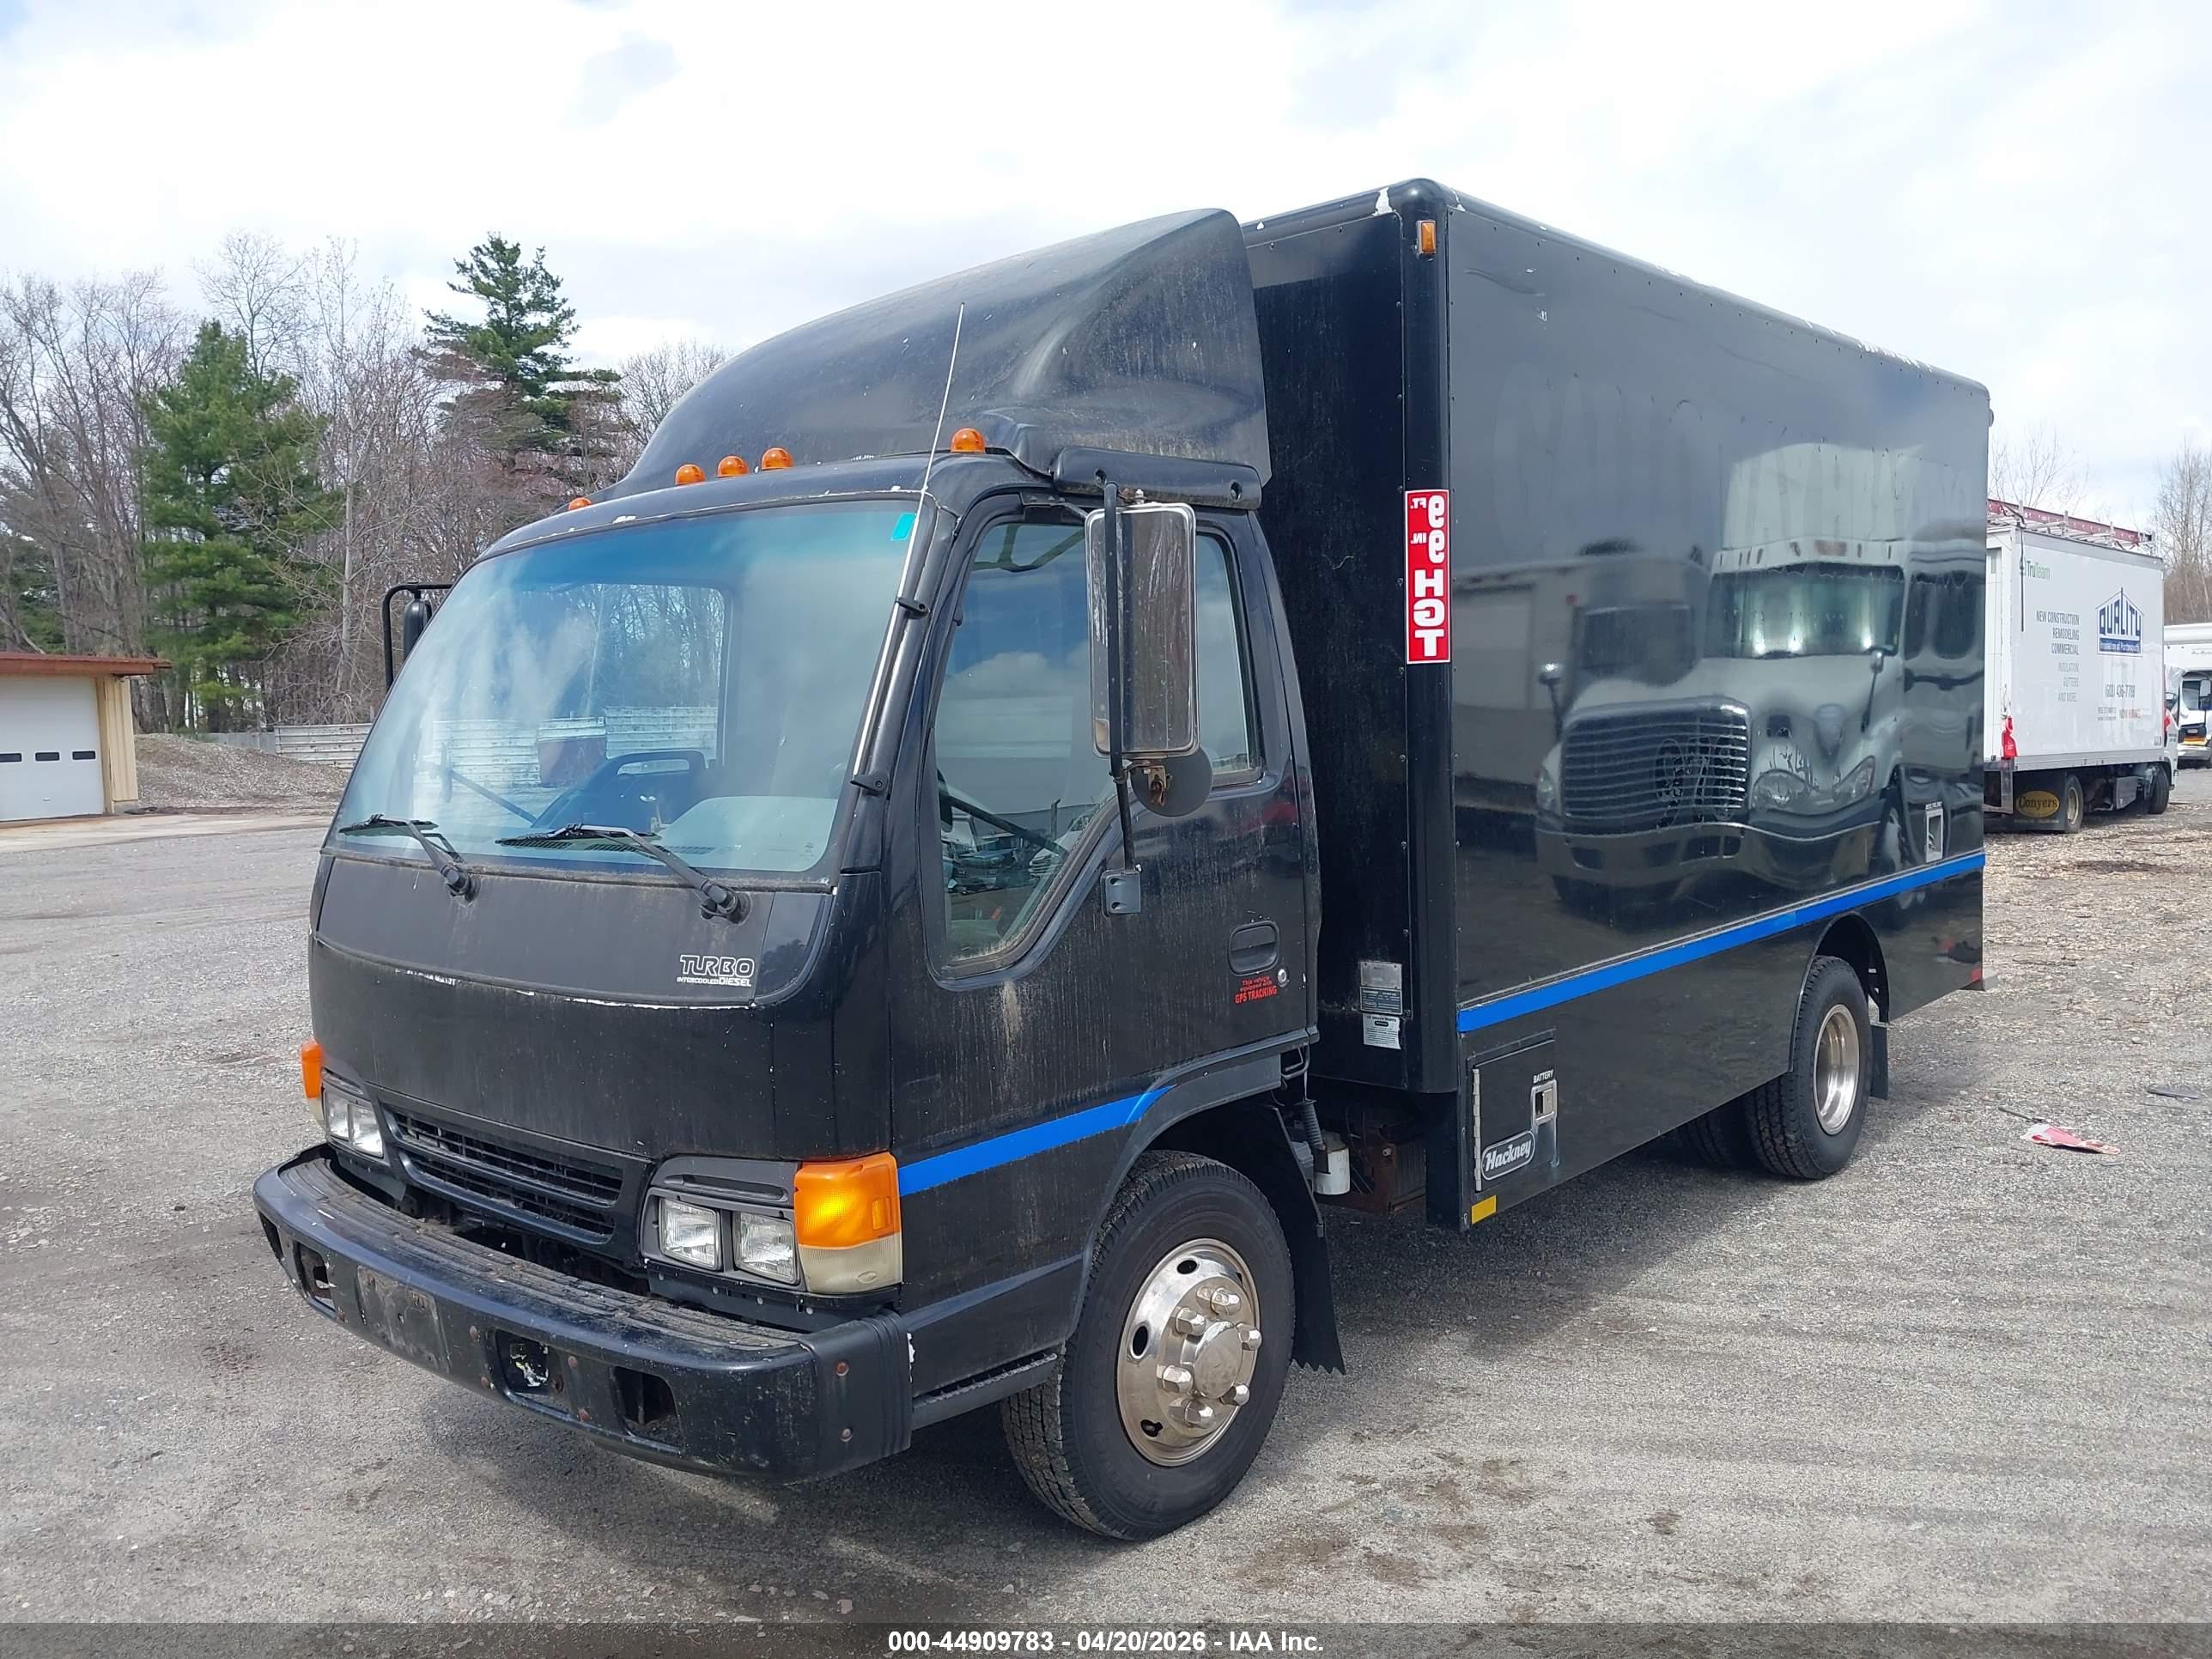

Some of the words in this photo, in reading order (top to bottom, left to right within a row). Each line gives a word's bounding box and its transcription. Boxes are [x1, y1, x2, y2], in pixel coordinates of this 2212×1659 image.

[2026, 560, 2051, 580] TruTeam
[2036, 611, 2047, 623] NEW
[2047, 611, 2080, 625] CONSTRUCTION
[2100, 597, 2142, 636] QUALITY
[2052, 627, 2080, 641] REMODELING
[2051, 643, 2080, 655] COMMERCIAL
[2019, 796, 2057, 811] Conyers
[679, 954, 755, 978] TURBO
[676, 976, 719, 985] INTERCOOLED
[718, 976, 752, 988] DIESEL
[1235, 992, 1248, 1003] GPS
[1248, 985, 1277, 1001] TRACKING
[1533, 1069, 1554, 1084] BATTERY
[1485, 1139, 1532, 1172] Hackney
